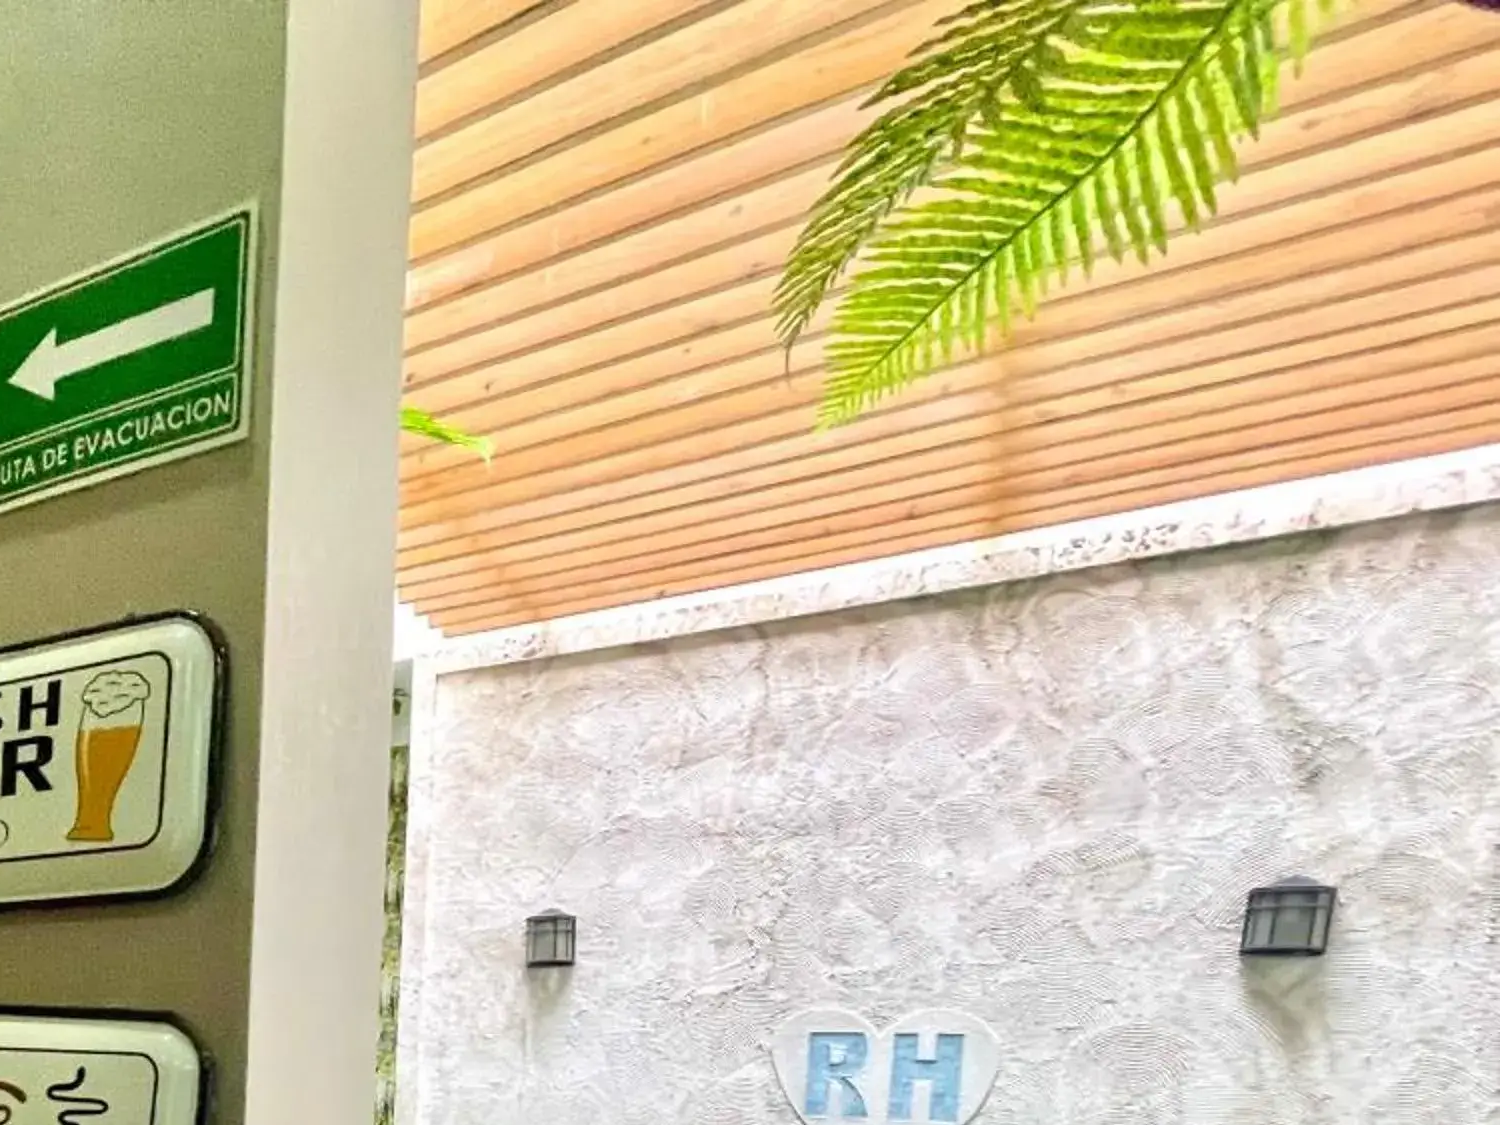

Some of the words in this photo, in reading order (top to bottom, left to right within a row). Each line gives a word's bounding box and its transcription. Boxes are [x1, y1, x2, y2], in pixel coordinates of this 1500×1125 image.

[42, 446, 68, 471] DE
[73, 390, 232, 461] EVACUACION
[804, 1031, 965, 1122] RH
